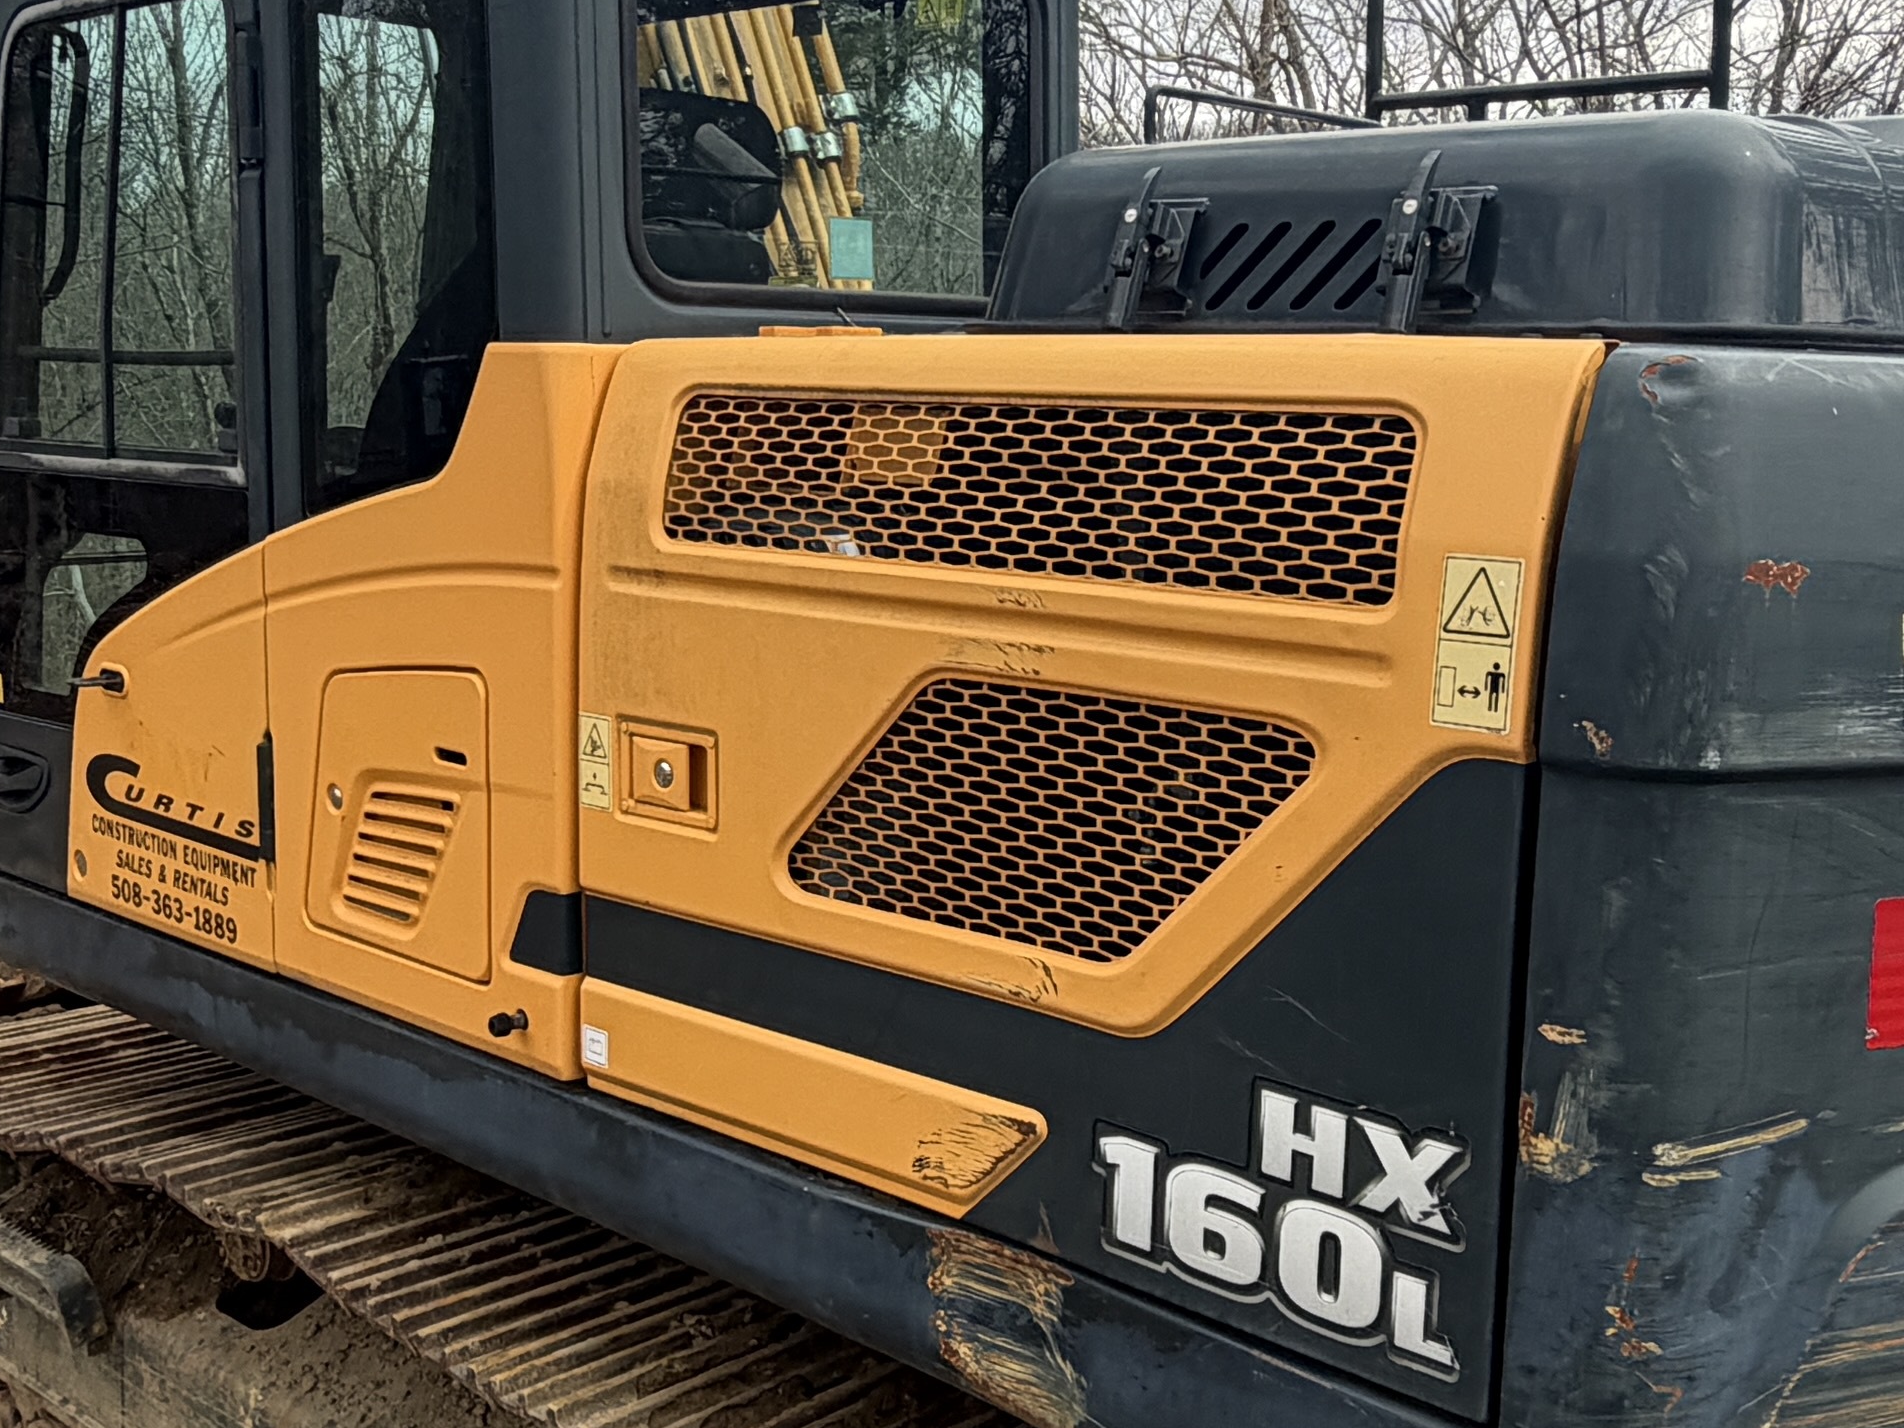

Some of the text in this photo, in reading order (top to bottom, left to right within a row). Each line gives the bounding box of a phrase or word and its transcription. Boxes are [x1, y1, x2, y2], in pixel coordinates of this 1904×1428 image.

[86, 753, 260, 862] CURTIS
[91, 813, 257, 888] CONSTRUCTION EQUIPMENT
[116, 848, 229, 907] SALES & RENTALS
[111, 873, 237, 944] 508-363-1889
[1260, 1088, 1466, 1236] HX
